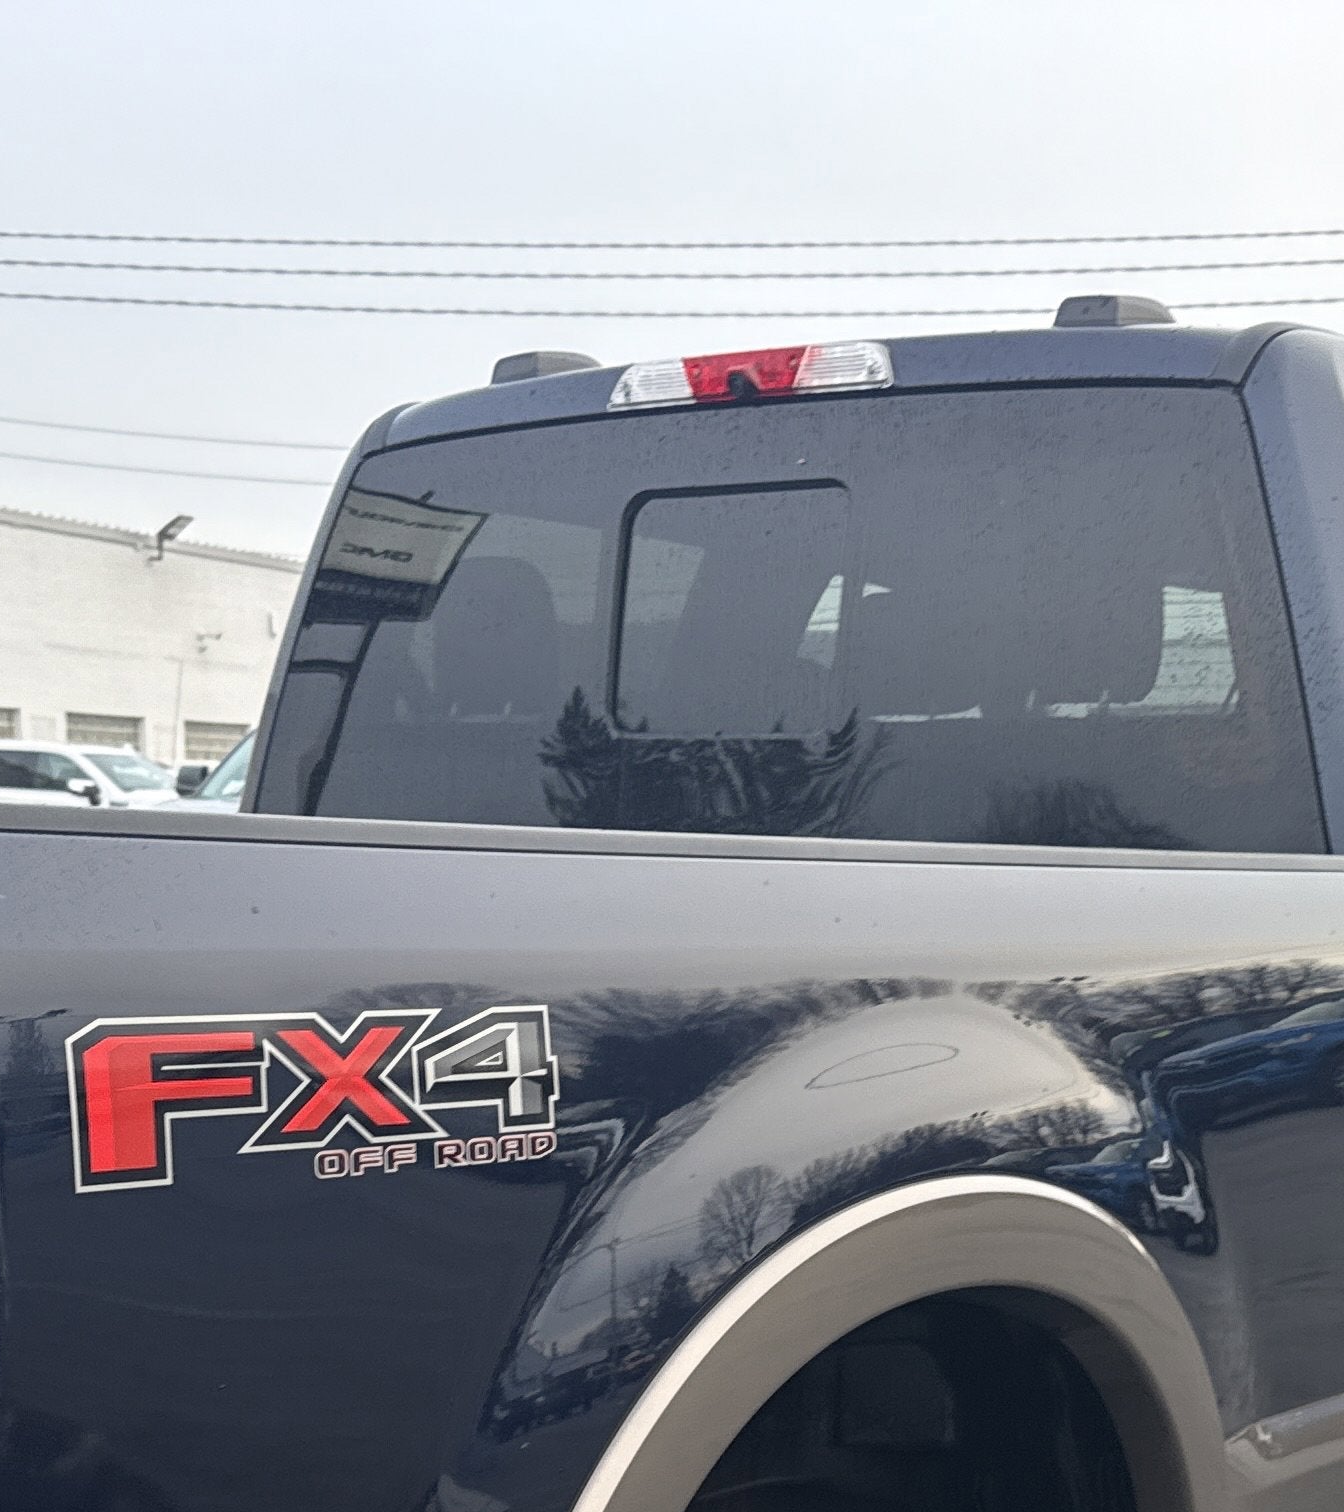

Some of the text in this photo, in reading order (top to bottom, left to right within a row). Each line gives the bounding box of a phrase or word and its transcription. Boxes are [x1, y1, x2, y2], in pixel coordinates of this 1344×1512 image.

[65, 1004, 561, 1194] FX4
[314, 1131, 557, 1180] OFF ROAD
